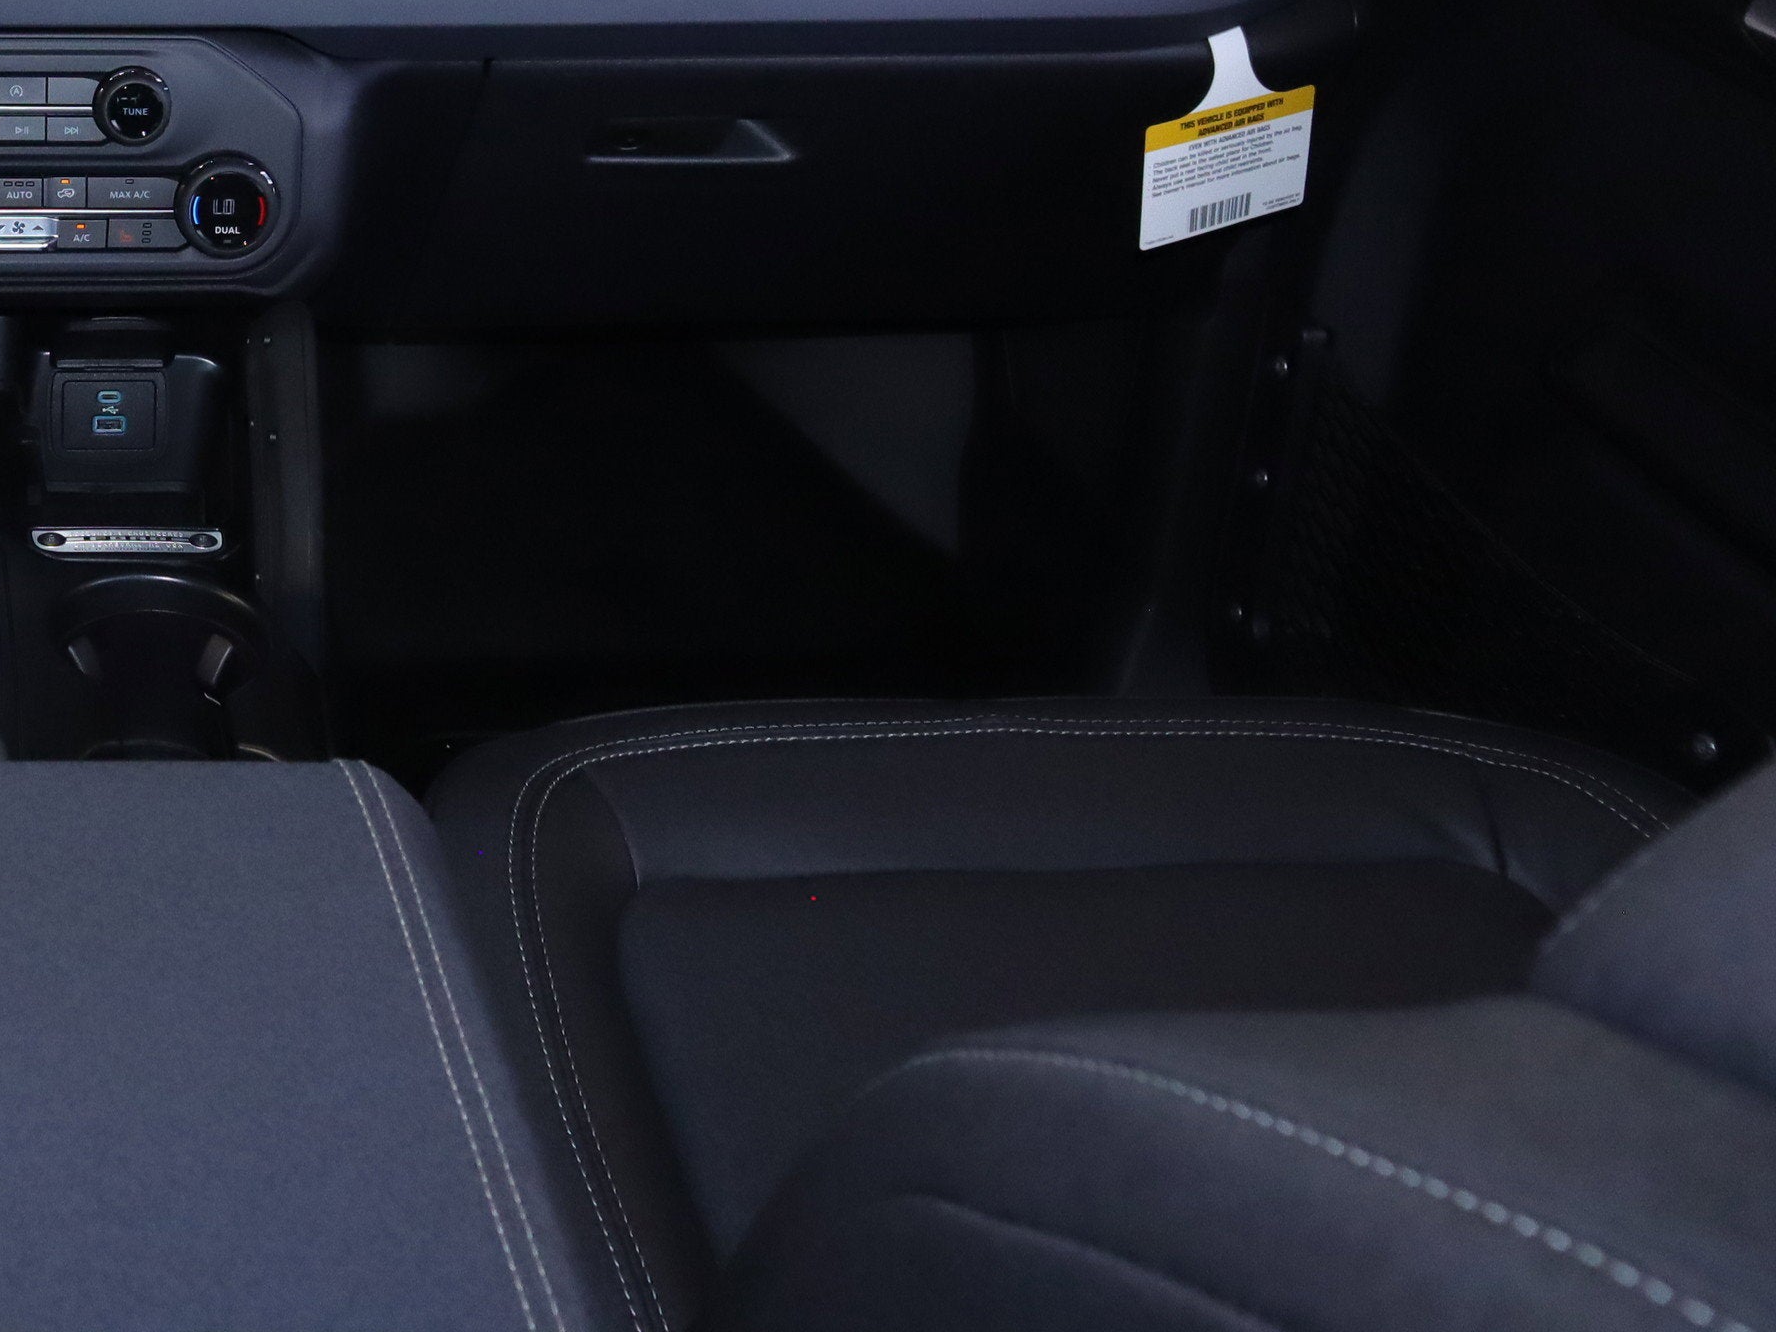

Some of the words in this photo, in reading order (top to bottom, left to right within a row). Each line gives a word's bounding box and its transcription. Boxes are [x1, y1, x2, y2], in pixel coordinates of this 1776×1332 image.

[122, 108, 149, 116] TUNE
[1180, 120, 1195, 130] THIS
[1197, 113, 1223, 126] VEHICLE
[1225, 111, 1232, 119] IS
[1233, 102, 1265, 117] EQUIPPED
[1266, 98, 1283, 108] WITH
[1197, 121, 1232, 136] ADVANCED
[1234, 118, 1246, 127] AIR
[1247, 113, 1264, 123] BAGS
[1188, 142, 1202, 151] EVEN
[1202, 138, 1217, 147] WITH
[1218, 131, 1245, 143] ADVANCED
[1246, 128, 1255, 136] AIR
[1256, 124, 1270, 133] BAGS
[6, 190, 33, 200] AUTO
[109, 190, 131, 199] MAX
[133, 190, 151, 200] A/C
[214, 225, 240, 235] DUAL
[73, 233, 91, 243] A/C
